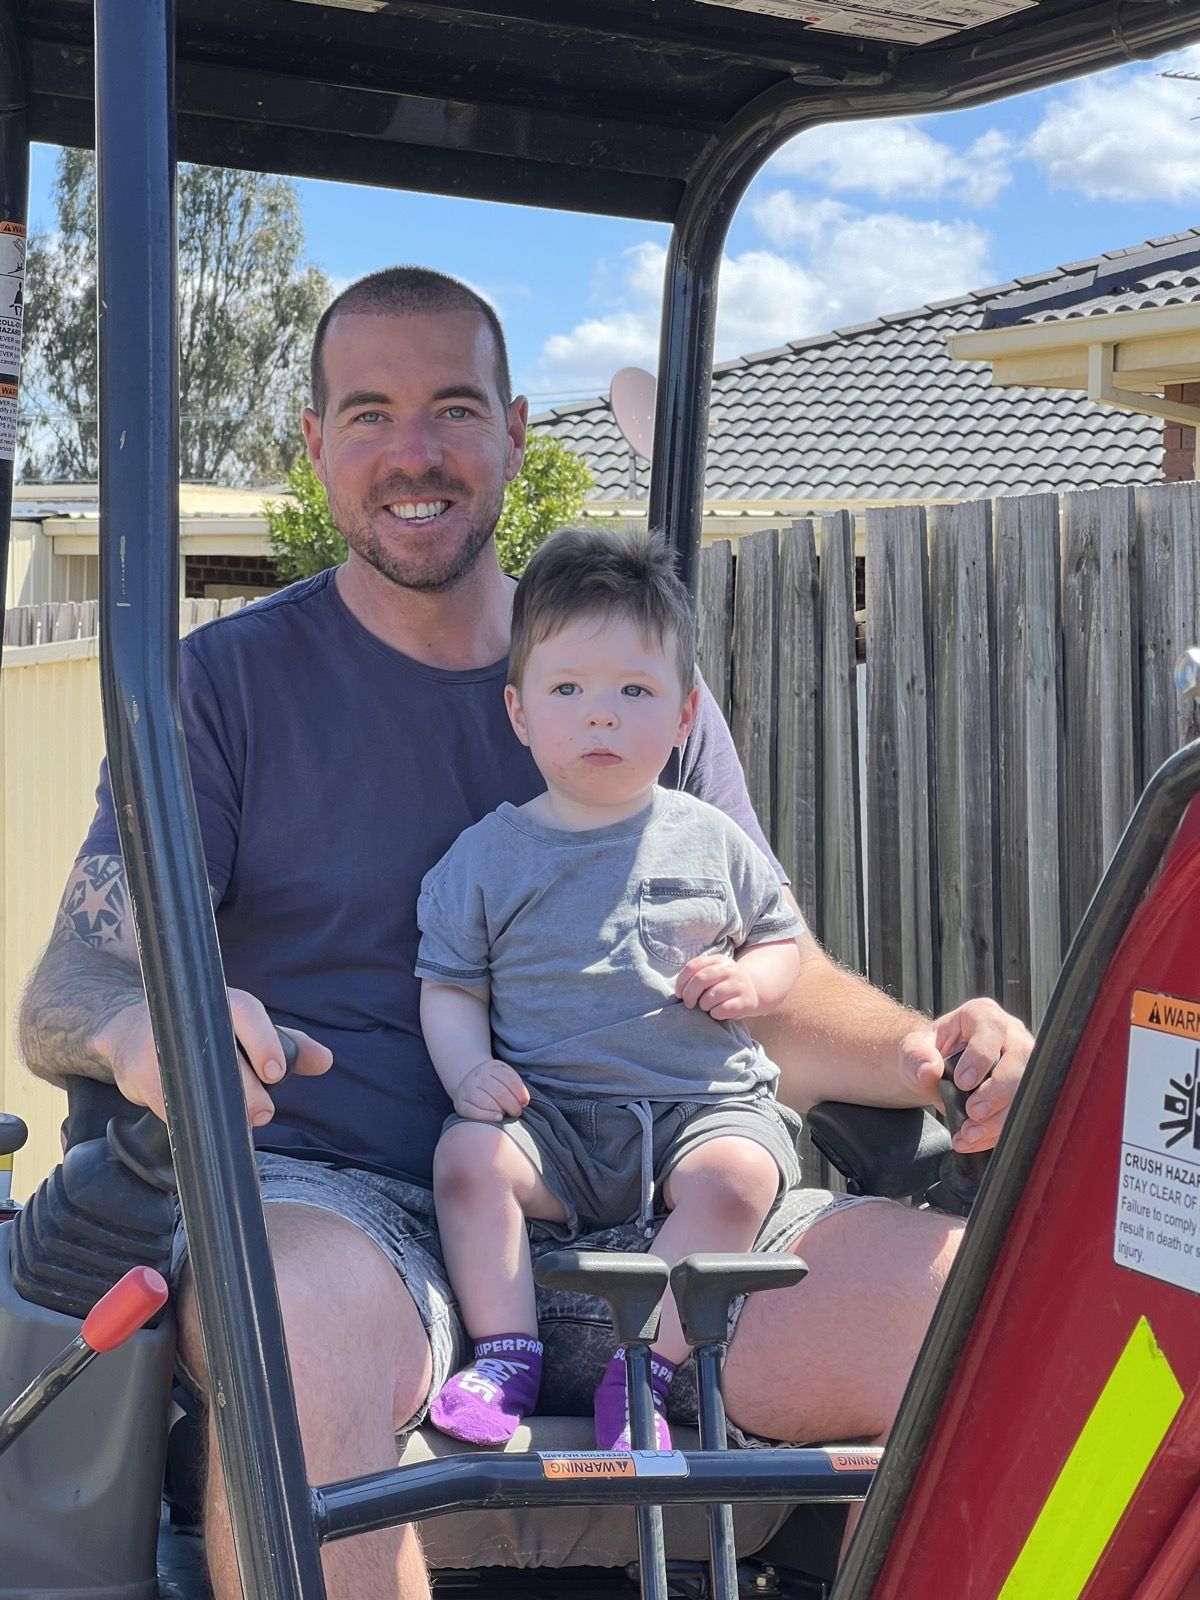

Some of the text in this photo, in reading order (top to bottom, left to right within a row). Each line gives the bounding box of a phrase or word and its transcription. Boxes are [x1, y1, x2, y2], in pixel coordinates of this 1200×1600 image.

[1125, 1153, 1163, 1177] CRUSH
[1123, 1174, 1198, 1210] STAY CLEAR OF
[1121, 1196, 1197, 1236] Failure to comply
[1120, 1221, 1144, 1239] result
[1146, 1226, 1155, 1242] in
[1157, 1232, 1181, 1251] death
[1184, 1243, 1194, 1255] or
[1118, 1240, 1145, 1263] injury.
[550, 1462, 616, 1474] WARNING
[837, 1456, 878, 1466] RNING
